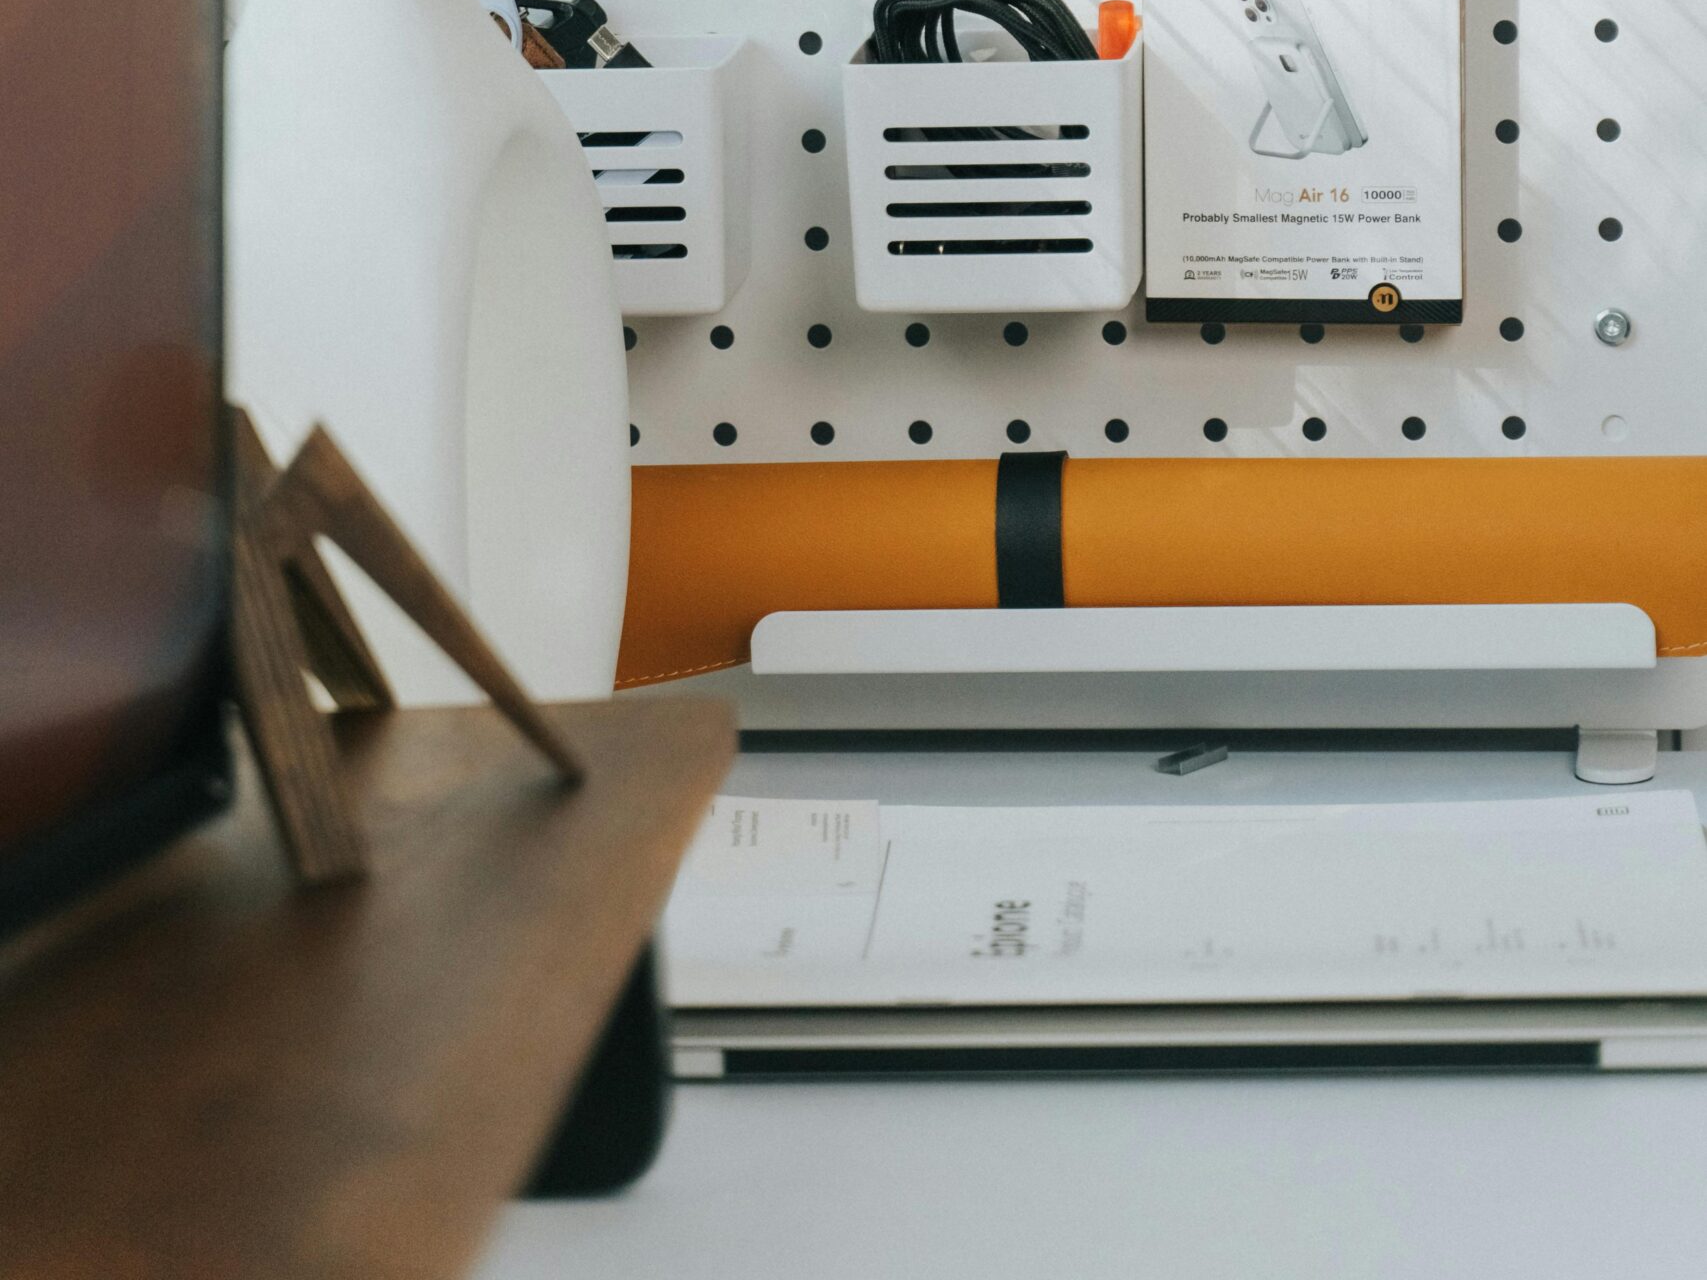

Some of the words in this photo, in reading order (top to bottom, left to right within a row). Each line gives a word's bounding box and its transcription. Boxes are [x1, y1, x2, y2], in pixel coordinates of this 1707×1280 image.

[1330, 187, 1350, 202] 16
[1363, 190, 1402, 200] 10000
[1183, 213, 1229, 224] Probably
[1233, 213, 1277, 223] Smallest
[1281, 213, 1328, 225] Magnetic
[1333, 213, 1354, 223] 15W
[1358, 213, 1391, 223] Power
[1394, 213, 1421, 223] Bank
